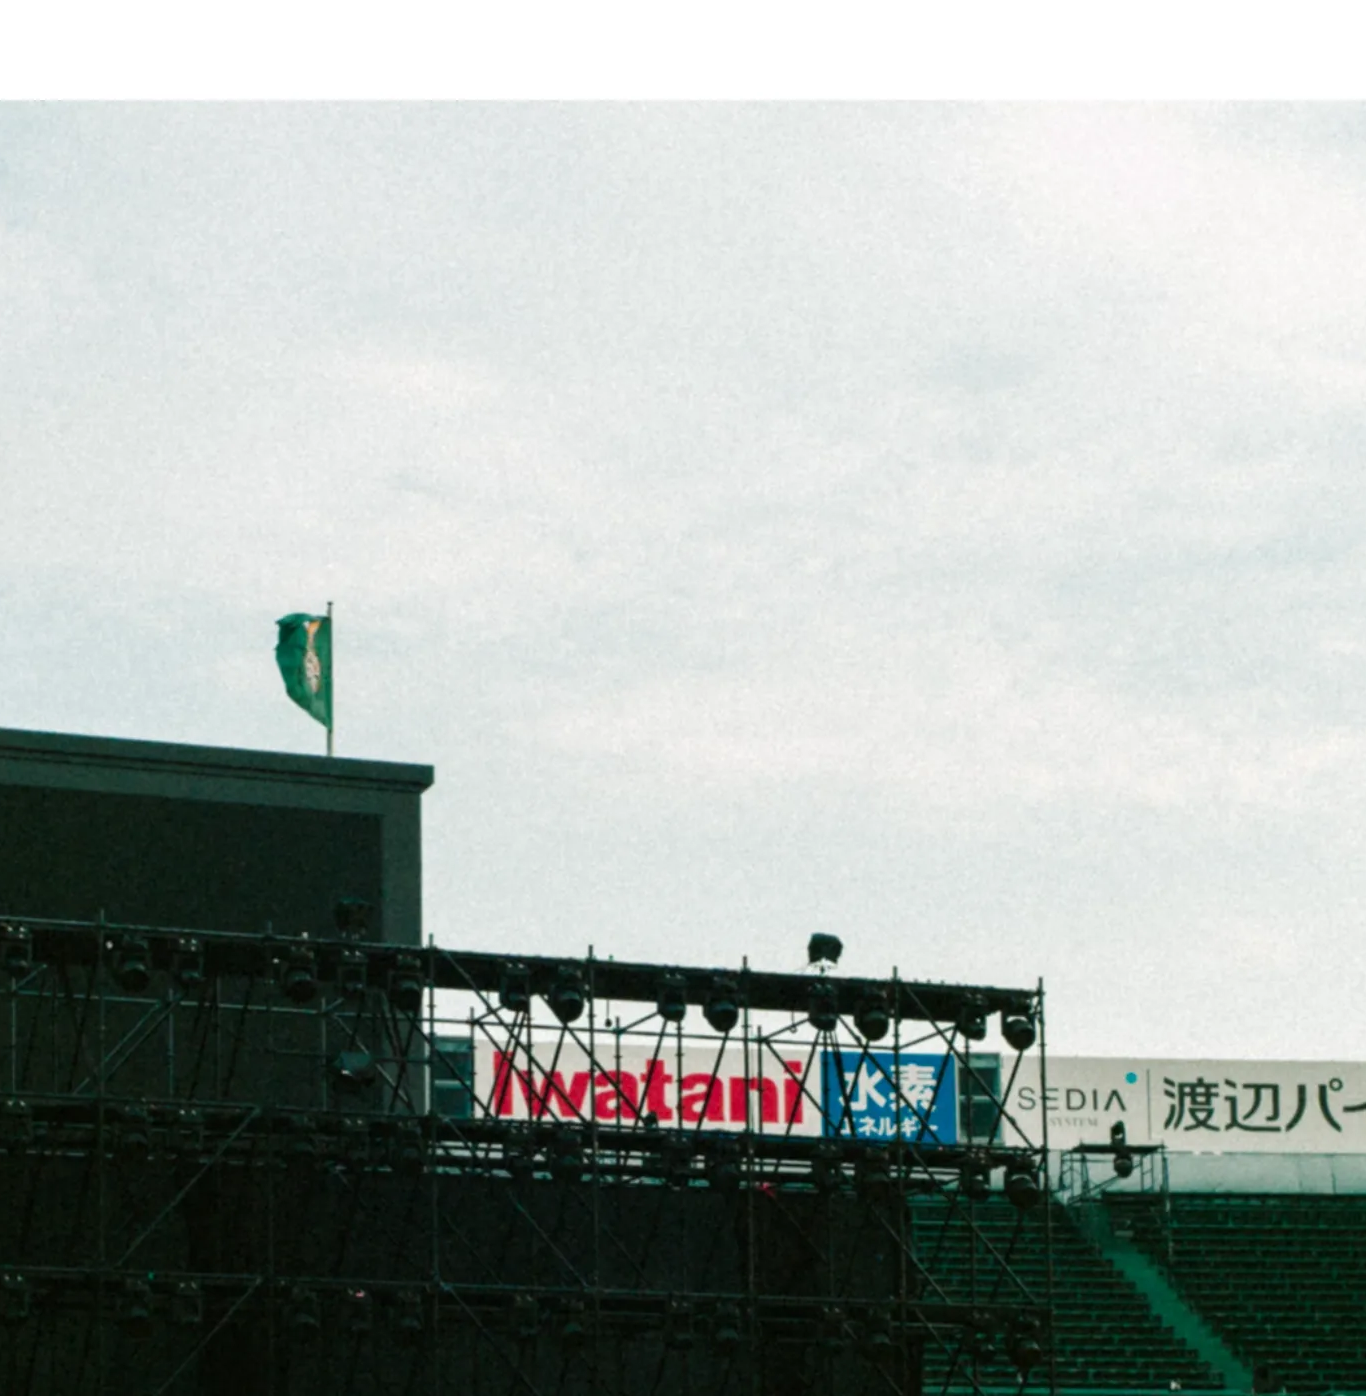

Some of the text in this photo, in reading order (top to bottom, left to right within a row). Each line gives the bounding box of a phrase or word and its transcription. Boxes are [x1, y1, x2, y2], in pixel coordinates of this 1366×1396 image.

[491, 1050, 804, 1125] Iwatani
[838, 1061, 938, 1113] 水素
[1017, 1086, 1127, 1112] SEDIA
[839, 1116, 939, 1138] エネルギー
[1048, 1115, 1099, 1128] SYSTEM
